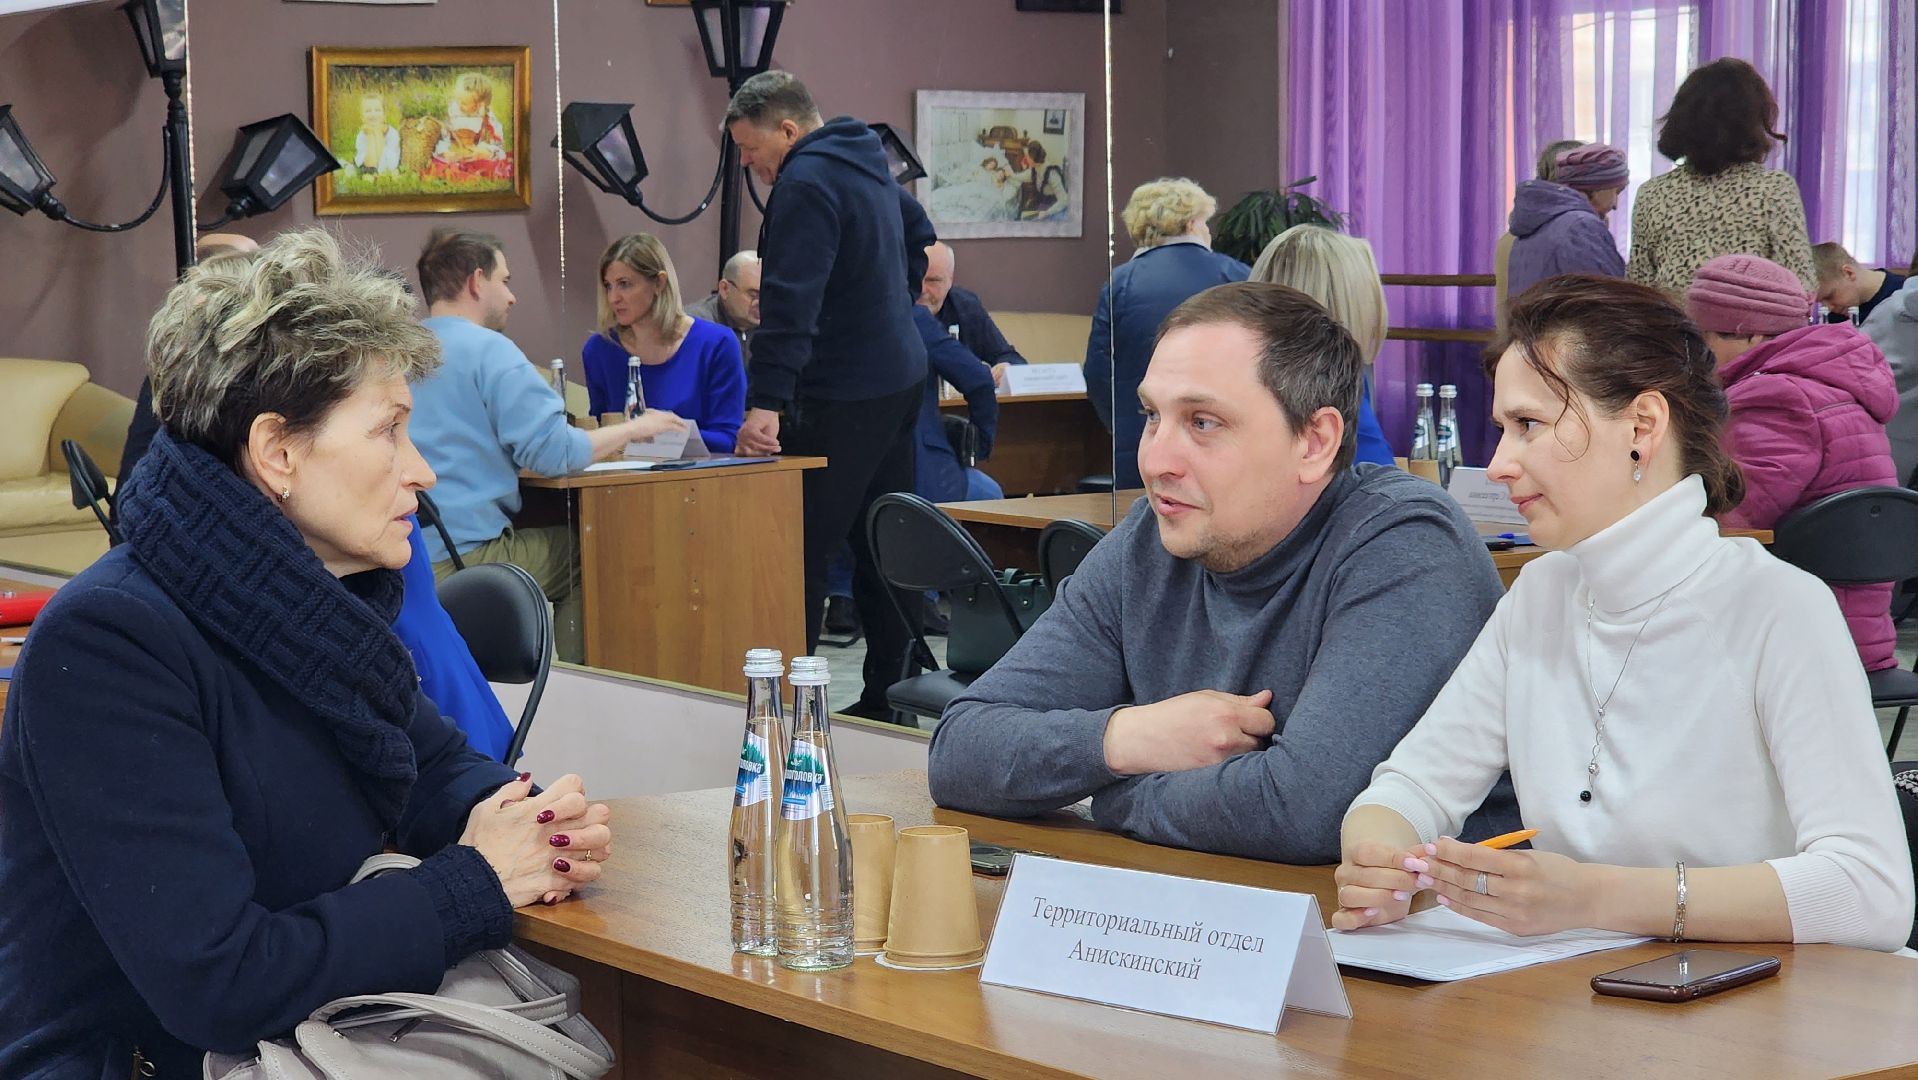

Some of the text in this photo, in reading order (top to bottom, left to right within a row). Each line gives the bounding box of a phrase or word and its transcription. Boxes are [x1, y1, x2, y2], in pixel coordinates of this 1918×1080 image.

[1032, 896, 1265, 953] Территориальный отдел
[1067, 938, 1202, 980] Анискинский
